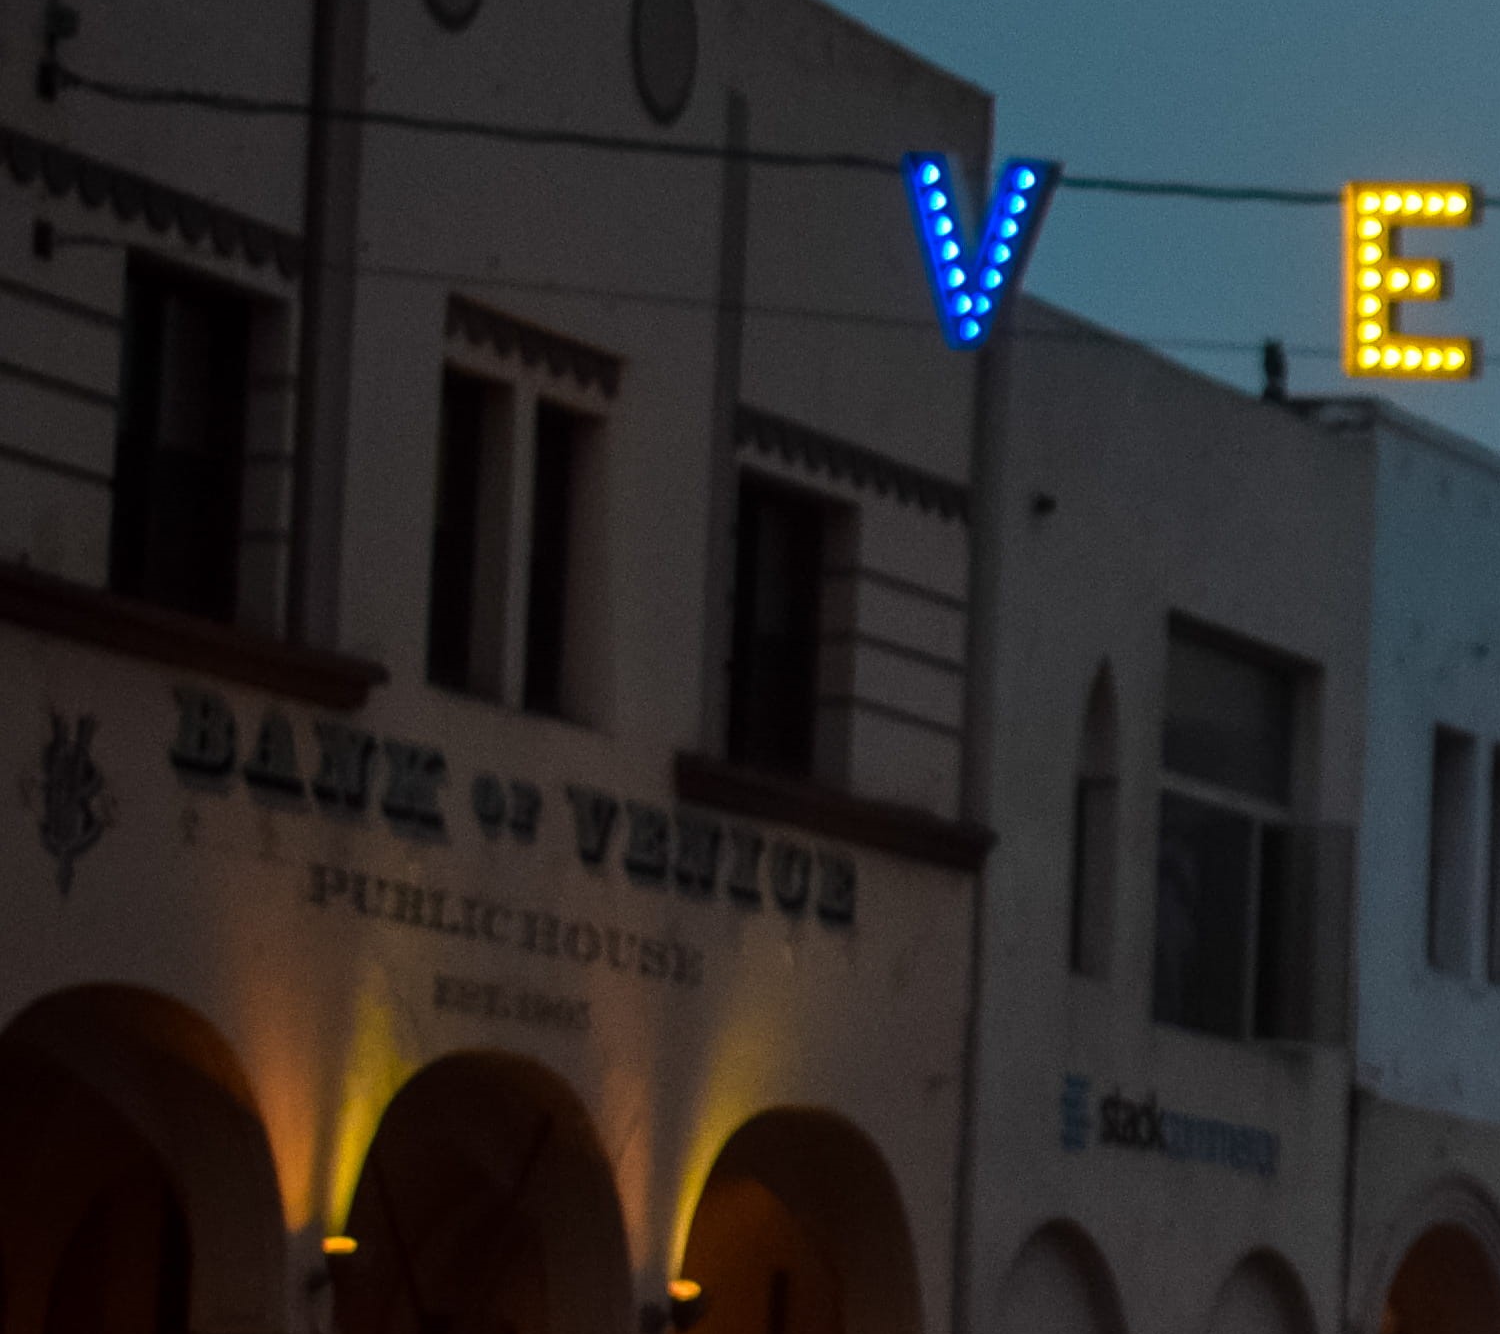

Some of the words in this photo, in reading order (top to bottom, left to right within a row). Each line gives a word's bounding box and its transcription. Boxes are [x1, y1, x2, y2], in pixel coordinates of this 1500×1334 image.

[171, 684, 447, 837] BANK
[472, 775, 542, 841] OF
[566, 783, 857, 930] VENICE
[309, 863, 512, 946] PUBLIC
[522, 908, 706, 987] HOUSE
